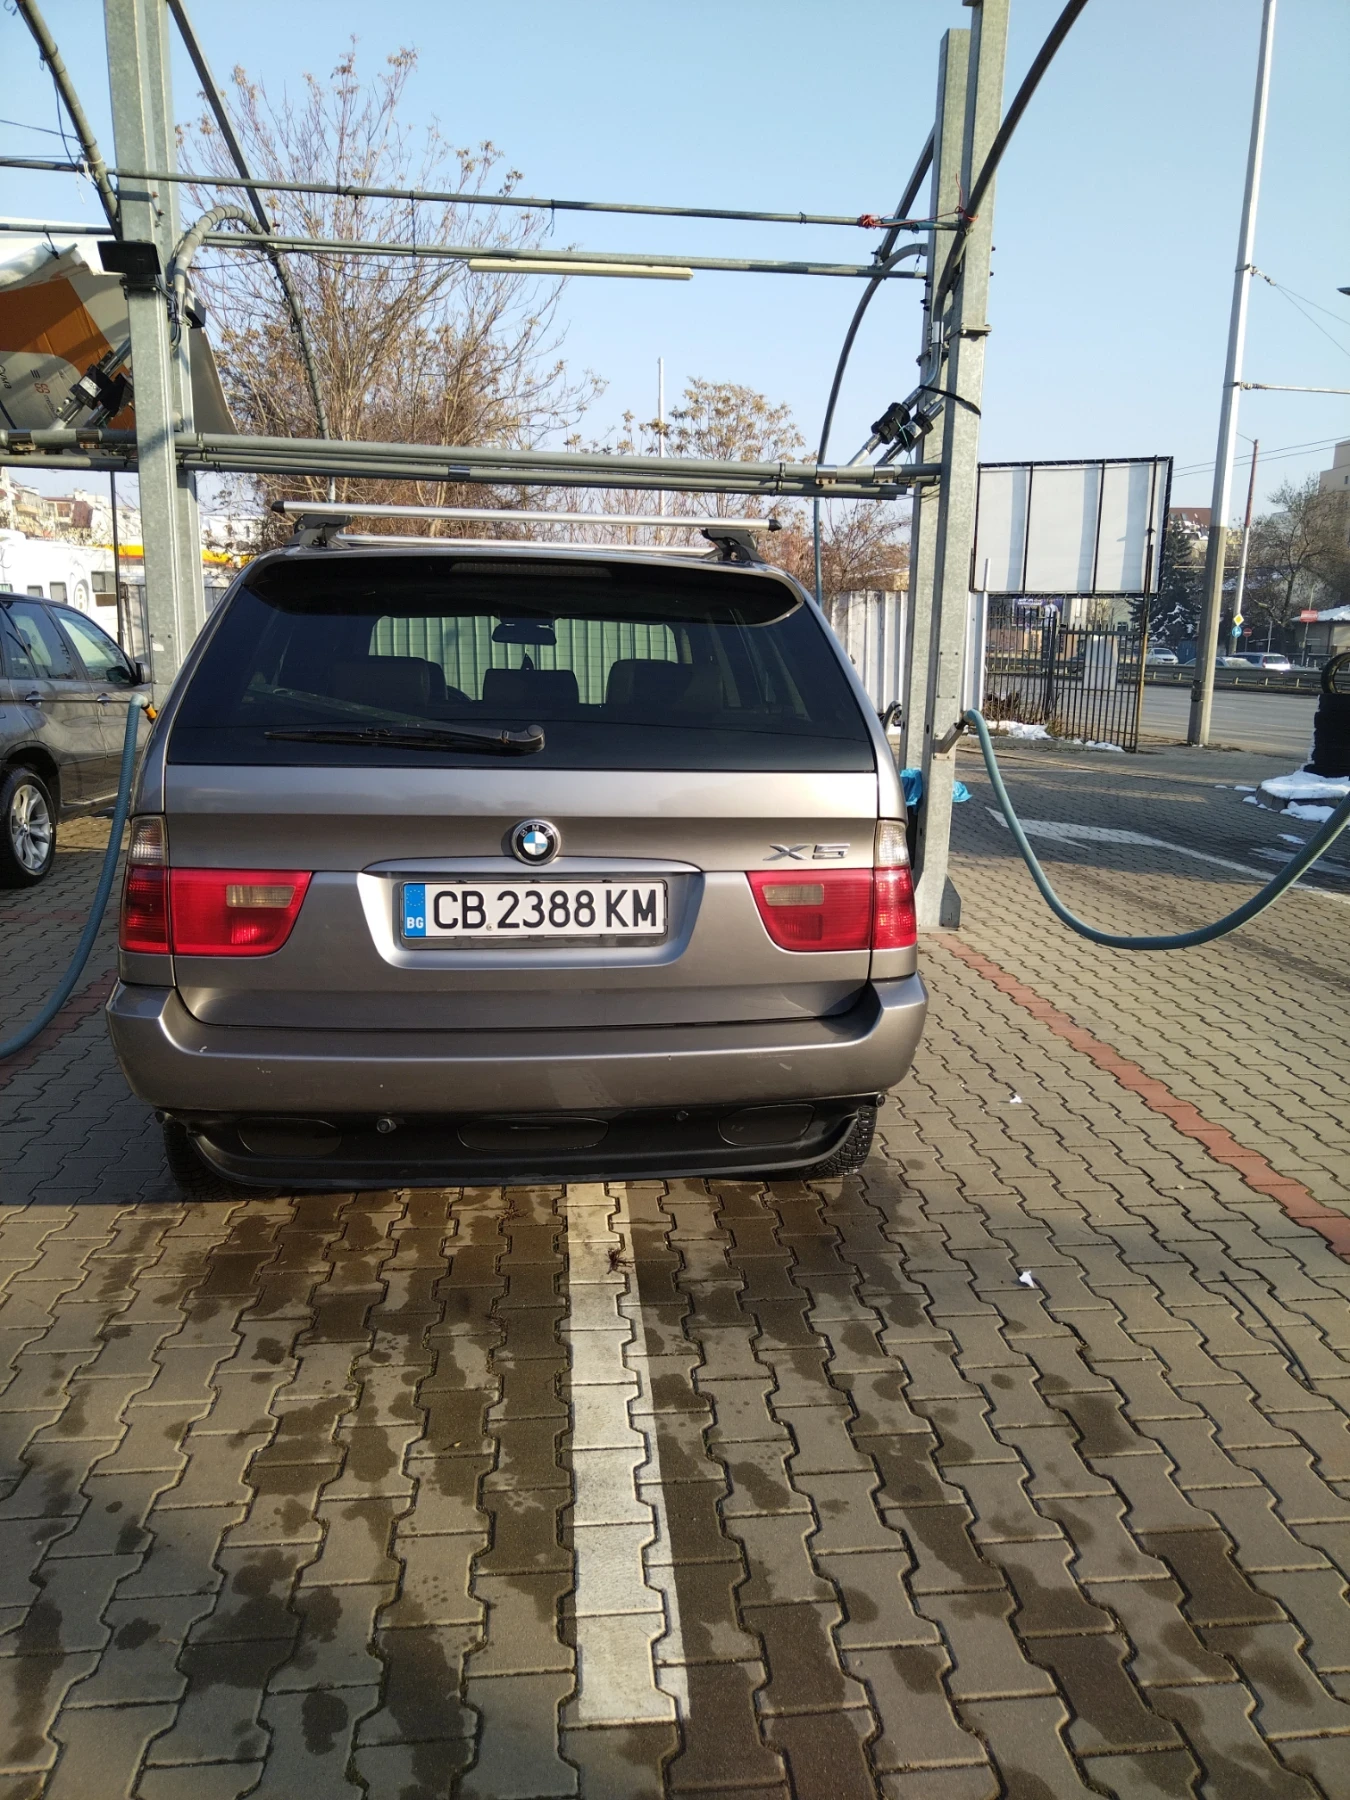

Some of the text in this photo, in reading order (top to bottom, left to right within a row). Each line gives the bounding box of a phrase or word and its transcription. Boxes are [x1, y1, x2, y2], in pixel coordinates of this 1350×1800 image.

[520, 824, 553, 837] BMW
[762, 843, 850, 861] X5
[434, 889, 657, 929] CB 2388 KM
[406, 917, 424, 929] BG
